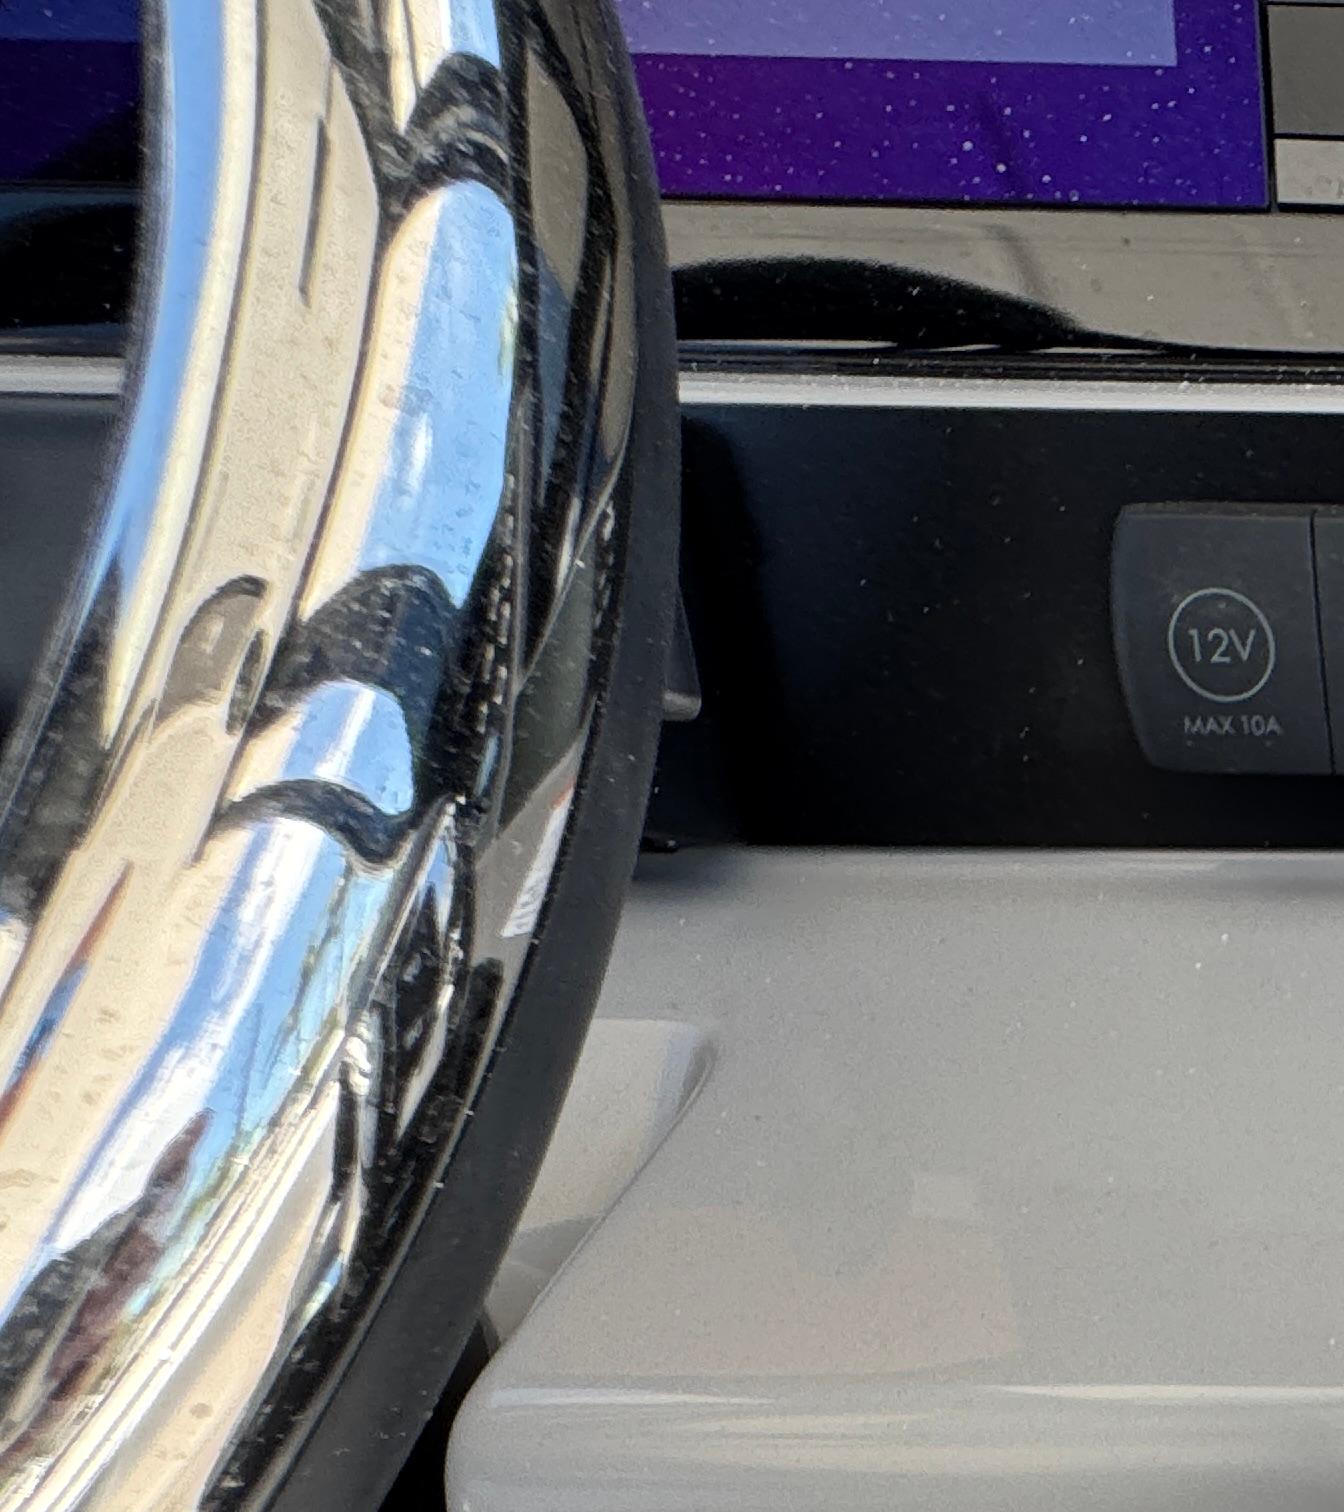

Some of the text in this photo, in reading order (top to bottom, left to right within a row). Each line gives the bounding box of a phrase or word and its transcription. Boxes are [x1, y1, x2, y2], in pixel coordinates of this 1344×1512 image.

[1188, 627, 1256, 664] 12V
[1184, 714, 1283, 737] MAX 10A
